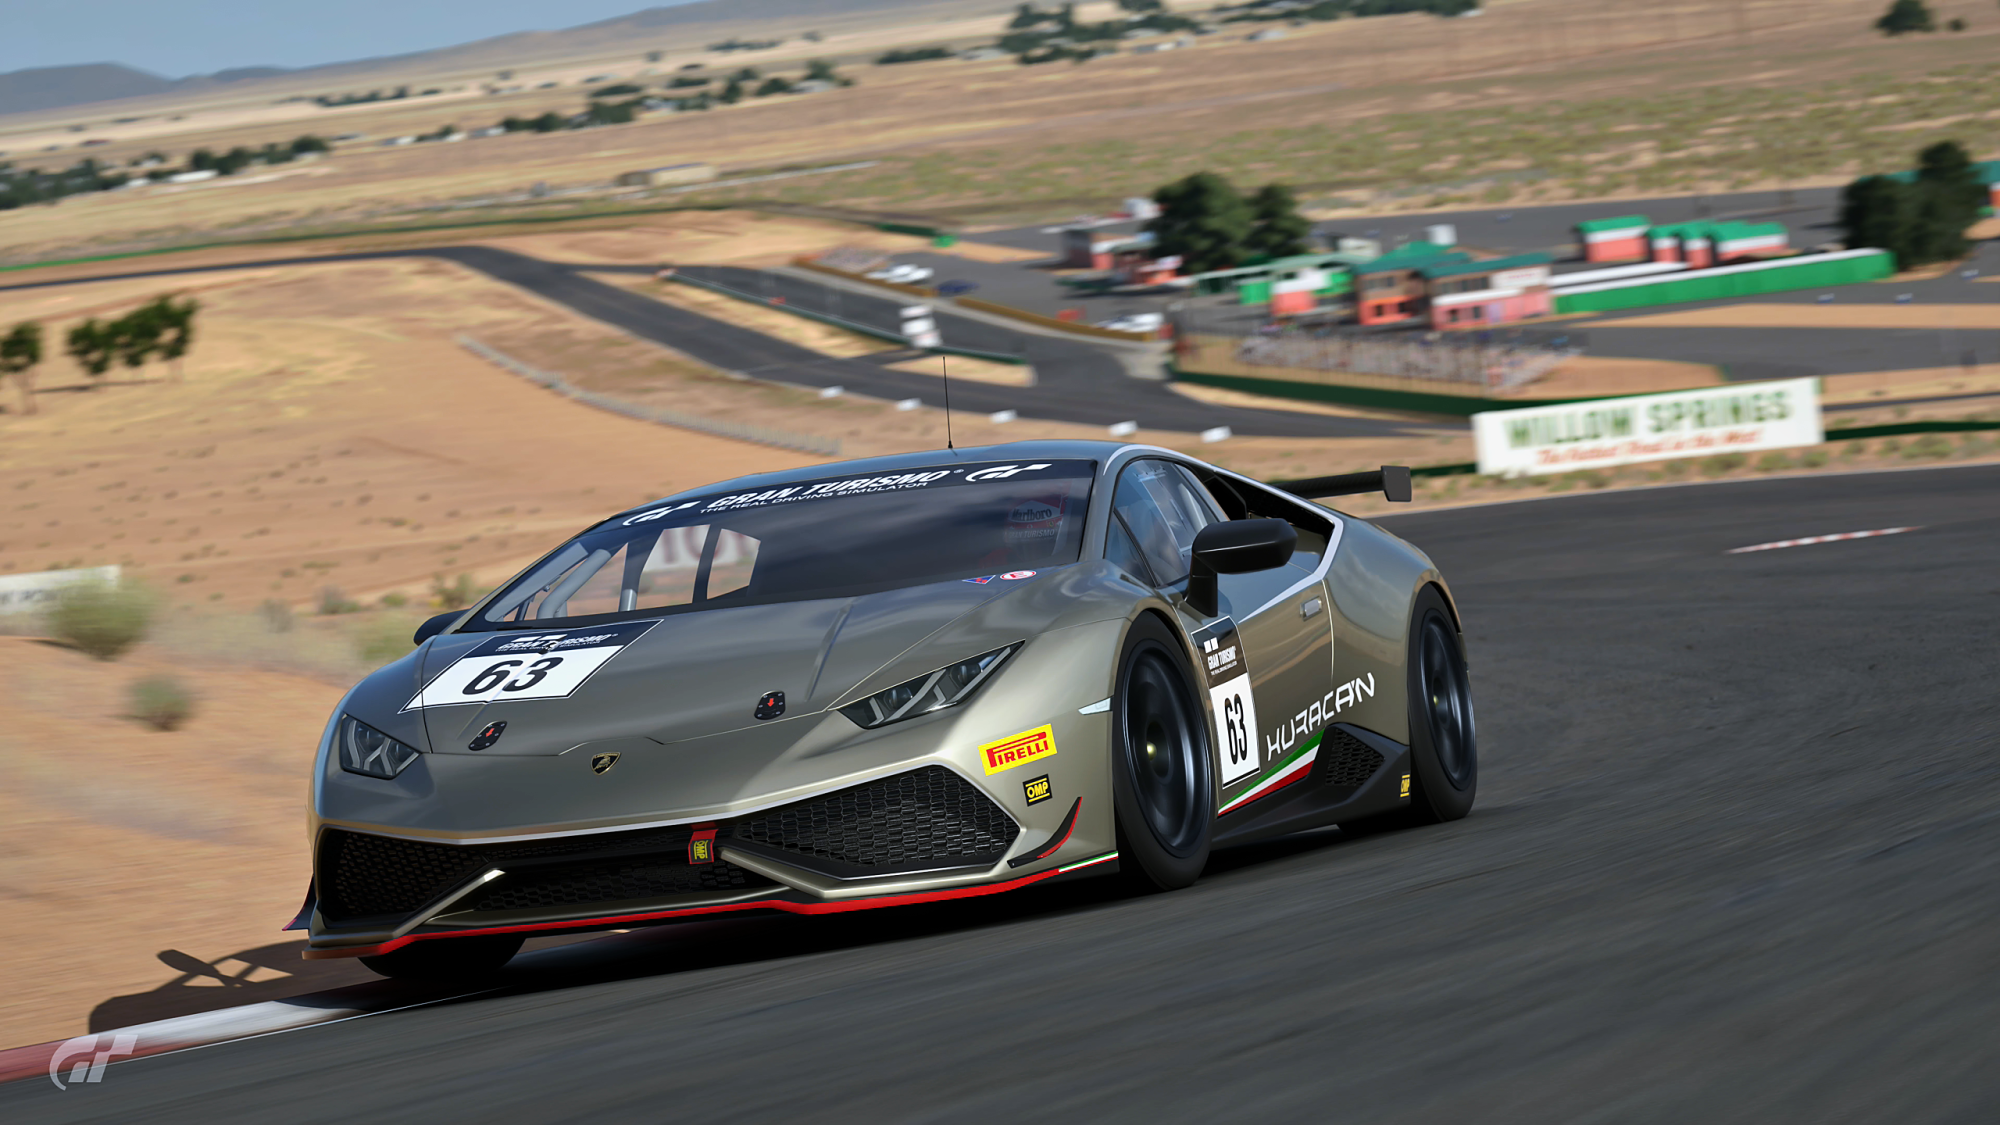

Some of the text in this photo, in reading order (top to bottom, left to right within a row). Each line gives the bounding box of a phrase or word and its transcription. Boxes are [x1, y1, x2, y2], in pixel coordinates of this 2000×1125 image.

[1503, 389, 1792, 448] WILLOW SPRINGS
[700, 482, 928, 514] THE REAL DRIVING SIMULATOR
[707, 486, 803, 509] GRAN
[1011, 508, 1053, 521] Marlboro
[462, 657, 564, 695] 63
[1224, 693, 1248, 765] 63
[986, 731, 1049, 768] PIRELLI
[1026, 781, 1049, 799] OMP
